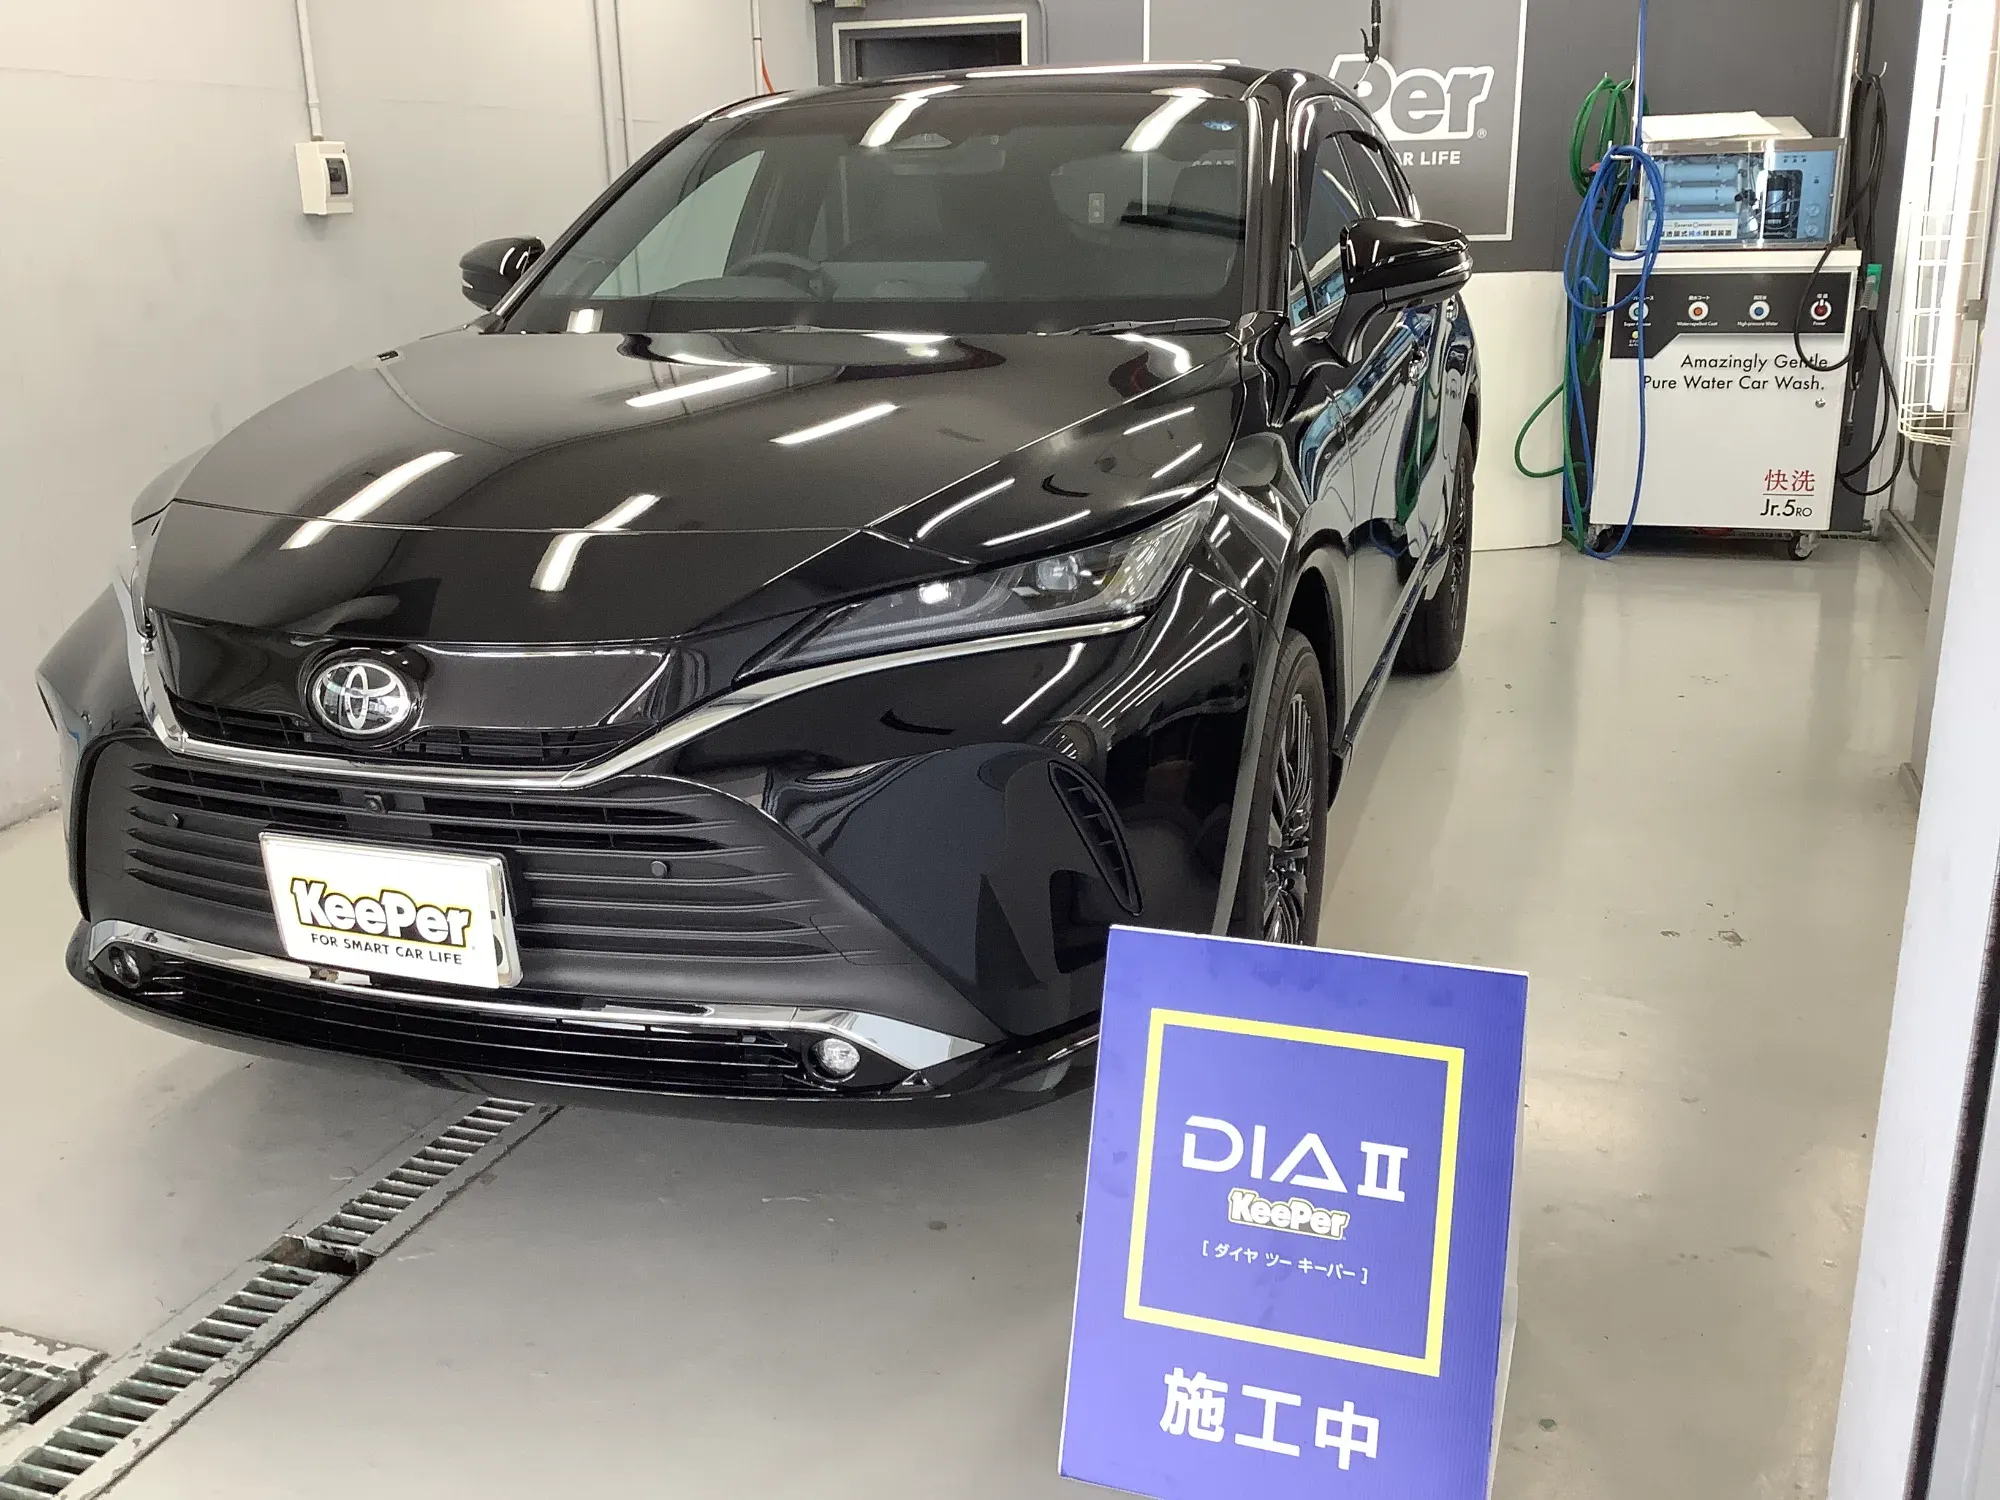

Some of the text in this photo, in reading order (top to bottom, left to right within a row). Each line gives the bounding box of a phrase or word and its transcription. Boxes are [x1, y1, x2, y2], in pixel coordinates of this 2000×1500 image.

[1420, 150, 1461, 166] LIFE
[1681, 353, 1768, 373] Amazingly
[1643, 374, 1825, 390] Pure Water Car Wash.
[1764, 468, 1816, 492] 快洗
[289, 876, 472, 949] KeePer
[311, 932, 463, 965] FOR SMART CAR LIFE
[1182, 1115, 1348, 1194] DIA
[1228, 1187, 1350, 1241] KeePer
[1159, 1366, 1380, 1471] 施工中
